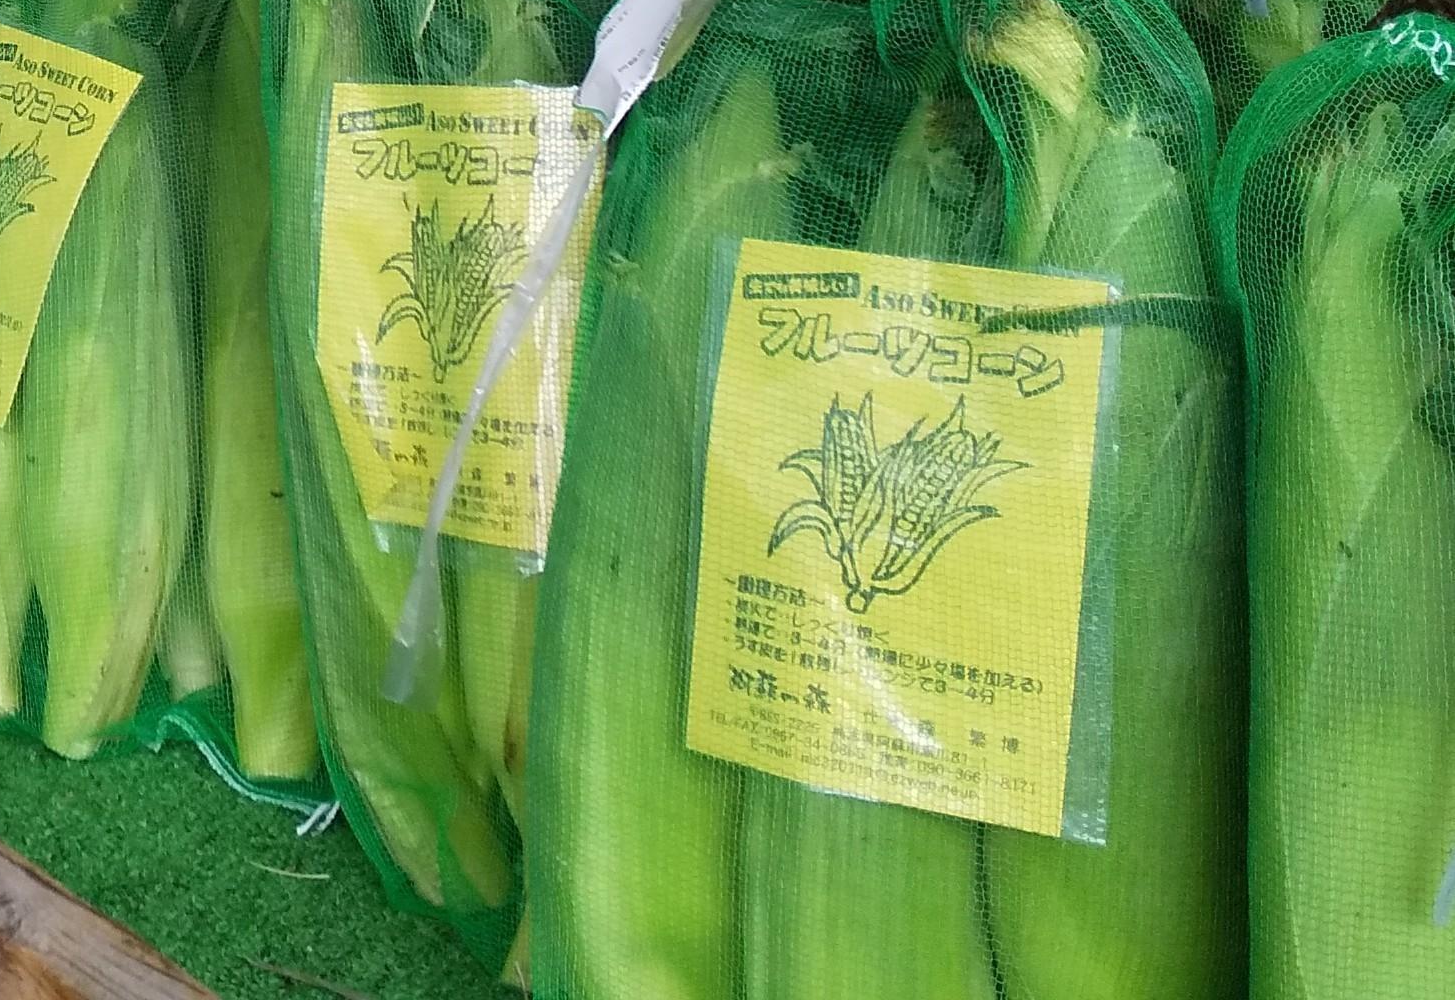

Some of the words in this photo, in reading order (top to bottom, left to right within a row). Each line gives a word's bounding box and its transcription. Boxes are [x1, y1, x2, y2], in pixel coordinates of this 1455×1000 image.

[758, 306, 1065, 399] フルーツコーン
